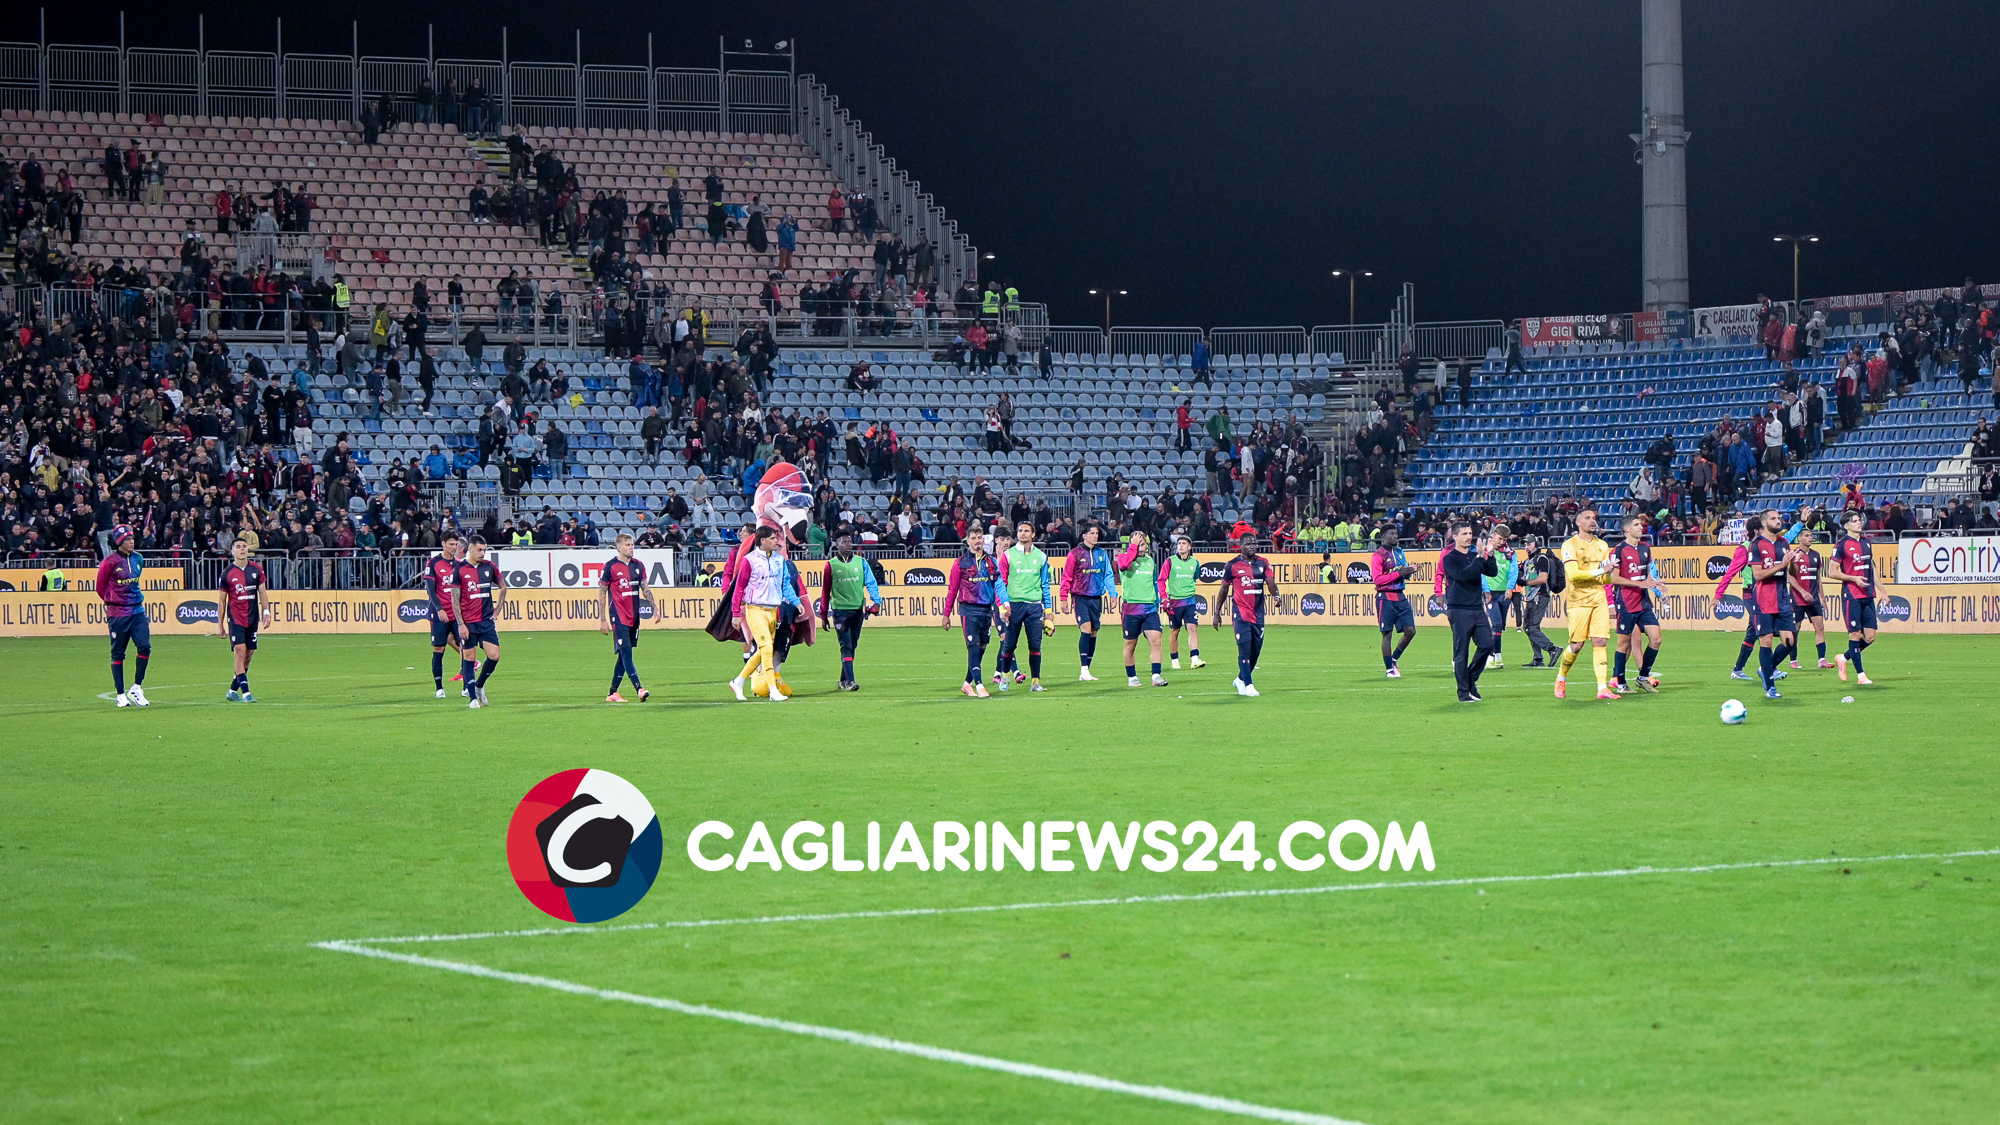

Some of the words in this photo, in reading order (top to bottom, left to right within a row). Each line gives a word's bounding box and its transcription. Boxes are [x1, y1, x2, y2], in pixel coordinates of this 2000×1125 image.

[1829, 295, 1854, 308] CAGLIARI
[1855, 294, 1867, 307] FAN
[1868, 292, 1883, 305] CLUB
[1544, 315, 1583, 324] CAGLIARI
[1585, 314, 1607, 323] CLUB
[1638, 320, 1668, 328] CAGLIARI
[1669, 318, 1685, 326] CLUB
[1713, 308, 1748, 324] CAGLIARI
[1550, 326, 1572, 337] GIGI
[1577, 325, 1601, 336] RIVA
[1644, 327, 1660, 335] GIGI
[1662, 326, 1678, 334] RIVA
[906, 573, 944, 584] Arborea
[1200, 566, 1226, 578] Arbo
[1304, 563, 1319, 583] GUST
[1679, 558, 1701, 579] UNICO
[3, 604, 14, 625] IL
[19, 603, 55, 625] LATTE
[61, 603, 82, 625] DAL
[87, 602, 108, 625] GUS
[286, 602, 306, 622] DAL
[312, 601, 348, 623] GUSTO
[354, 601, 388, 623] UNICO
[400, 605, 429, 617] Arbo
[503, 600, 523, 620] DAL
[527, 600, 562, 620] GUSTO
[567, 599, 600, 620] UNICO
[659, 599, 669, 618] IL
[674, 599, 705, 619] LATTE
[880, 597, 905, 616] ATTE
[909, 596, 927, 616] DAL
[1330, 594, 1336, 616] IL
[1339, 594, 1359, 616] LATTE
[1363, 594, 1375, 616] DAL
[1685, 595, 1711, 620] UNICO
[1916, 596, 1925, 623] IL
[1929, 596, 1957, 623] LATTE
[1961, 596, 1977, 622] DAL
